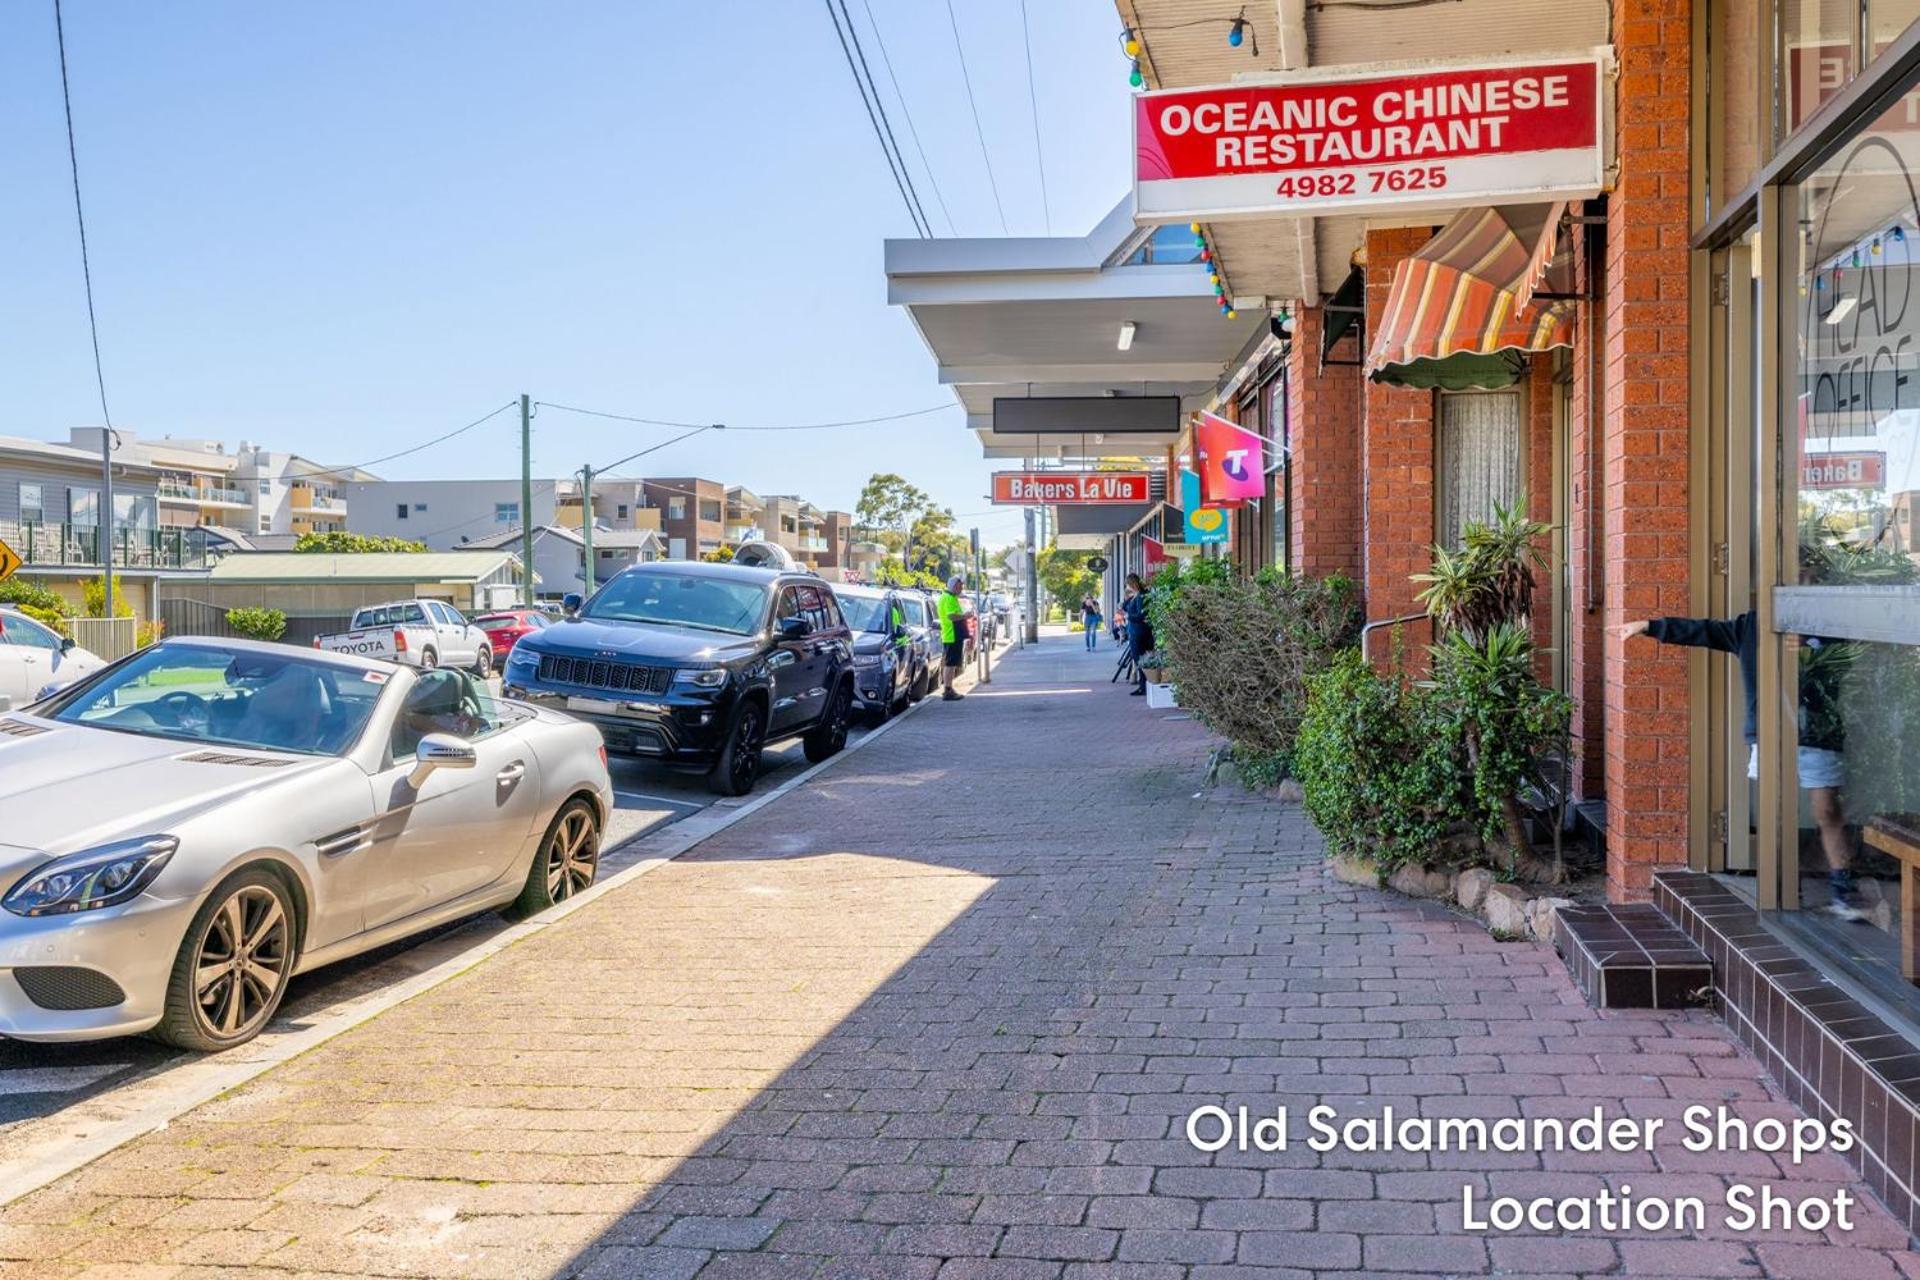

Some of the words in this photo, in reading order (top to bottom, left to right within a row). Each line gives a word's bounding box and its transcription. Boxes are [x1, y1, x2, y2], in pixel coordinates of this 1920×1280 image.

[1160, 96, 1358, 136] OCEANIC
[1373, 76, 1569, 124] CHINESE
[1215, 116, 1509, 168] RESTAURANT
[1276, 173, 1356, 199] 4982
[1369, 166, 1447, 193] 7625
[1010, 479, 1075, 499] Bakers
[1079, 479, 1099, 499] La
[1103, 478, 1133, 499] Vie
[332, 640, 385, 655] TOYOTA
